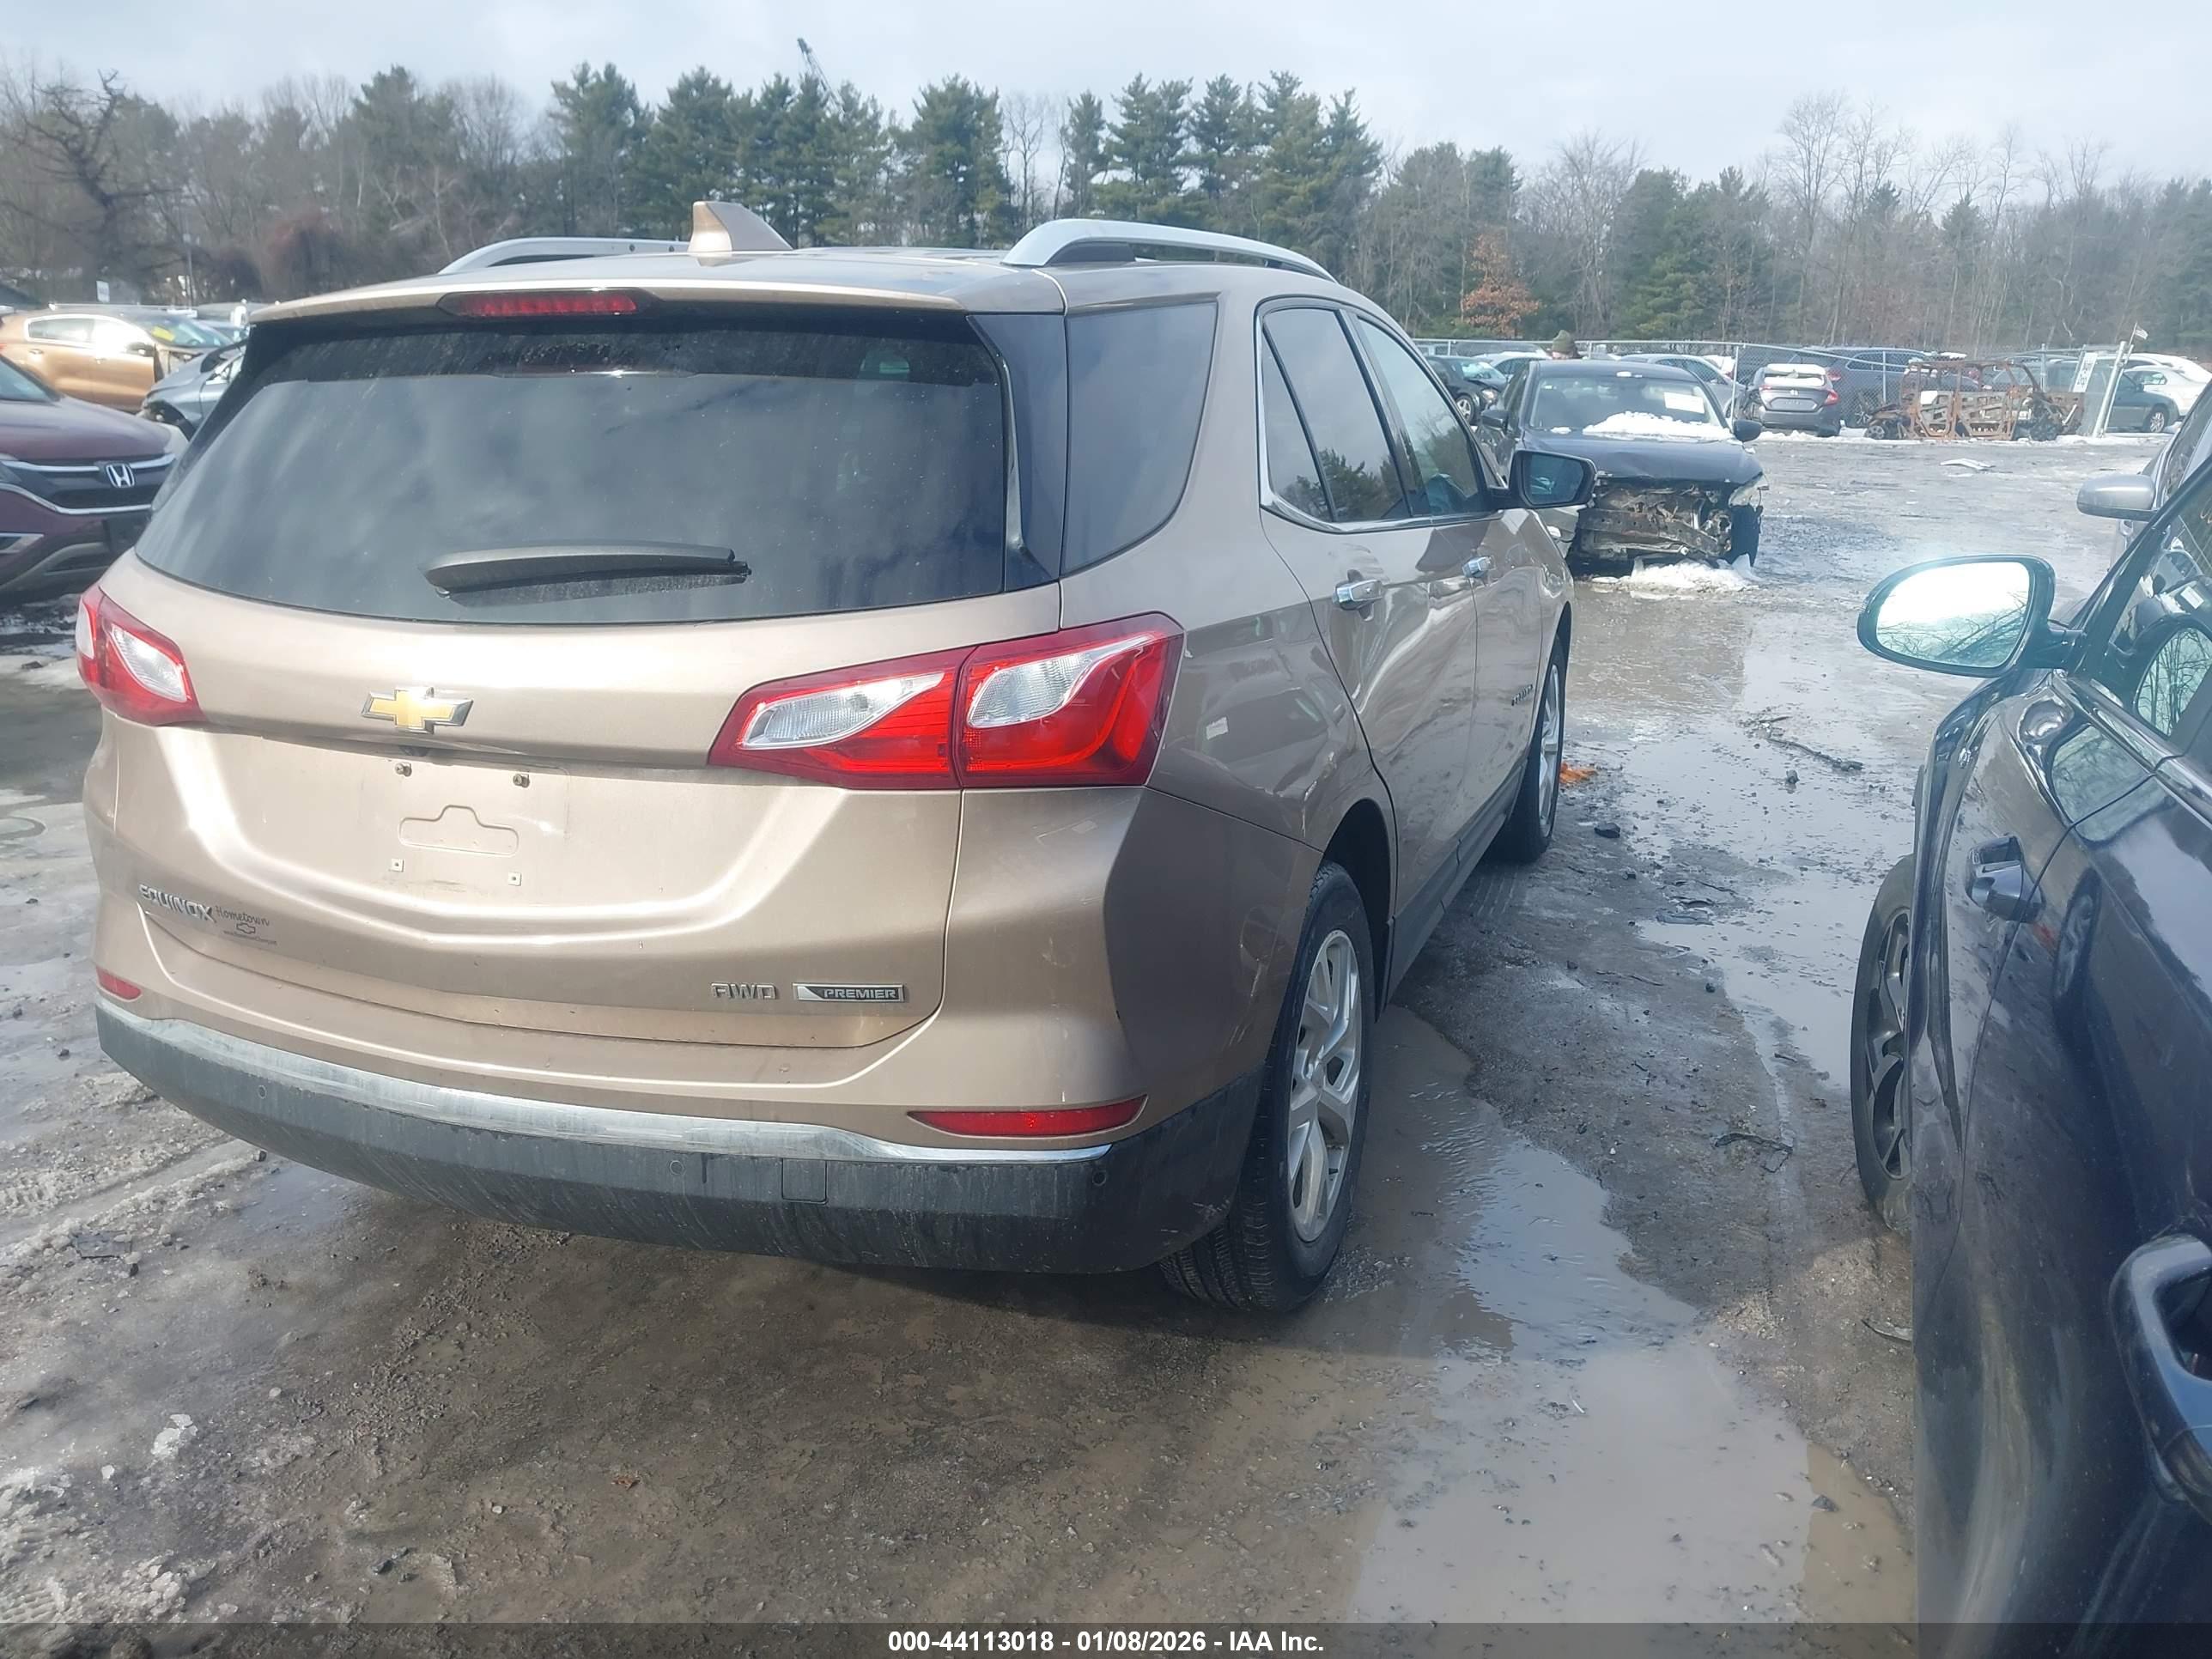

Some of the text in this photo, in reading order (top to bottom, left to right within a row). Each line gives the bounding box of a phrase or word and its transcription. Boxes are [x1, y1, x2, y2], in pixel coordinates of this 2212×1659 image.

[139, 884, 217, 923] EQUINOX
[215, 905, 270, 927] Hometown
[710, 982, 776, 1000] AWD
[823, 988, 896, 1000] PREMIER
